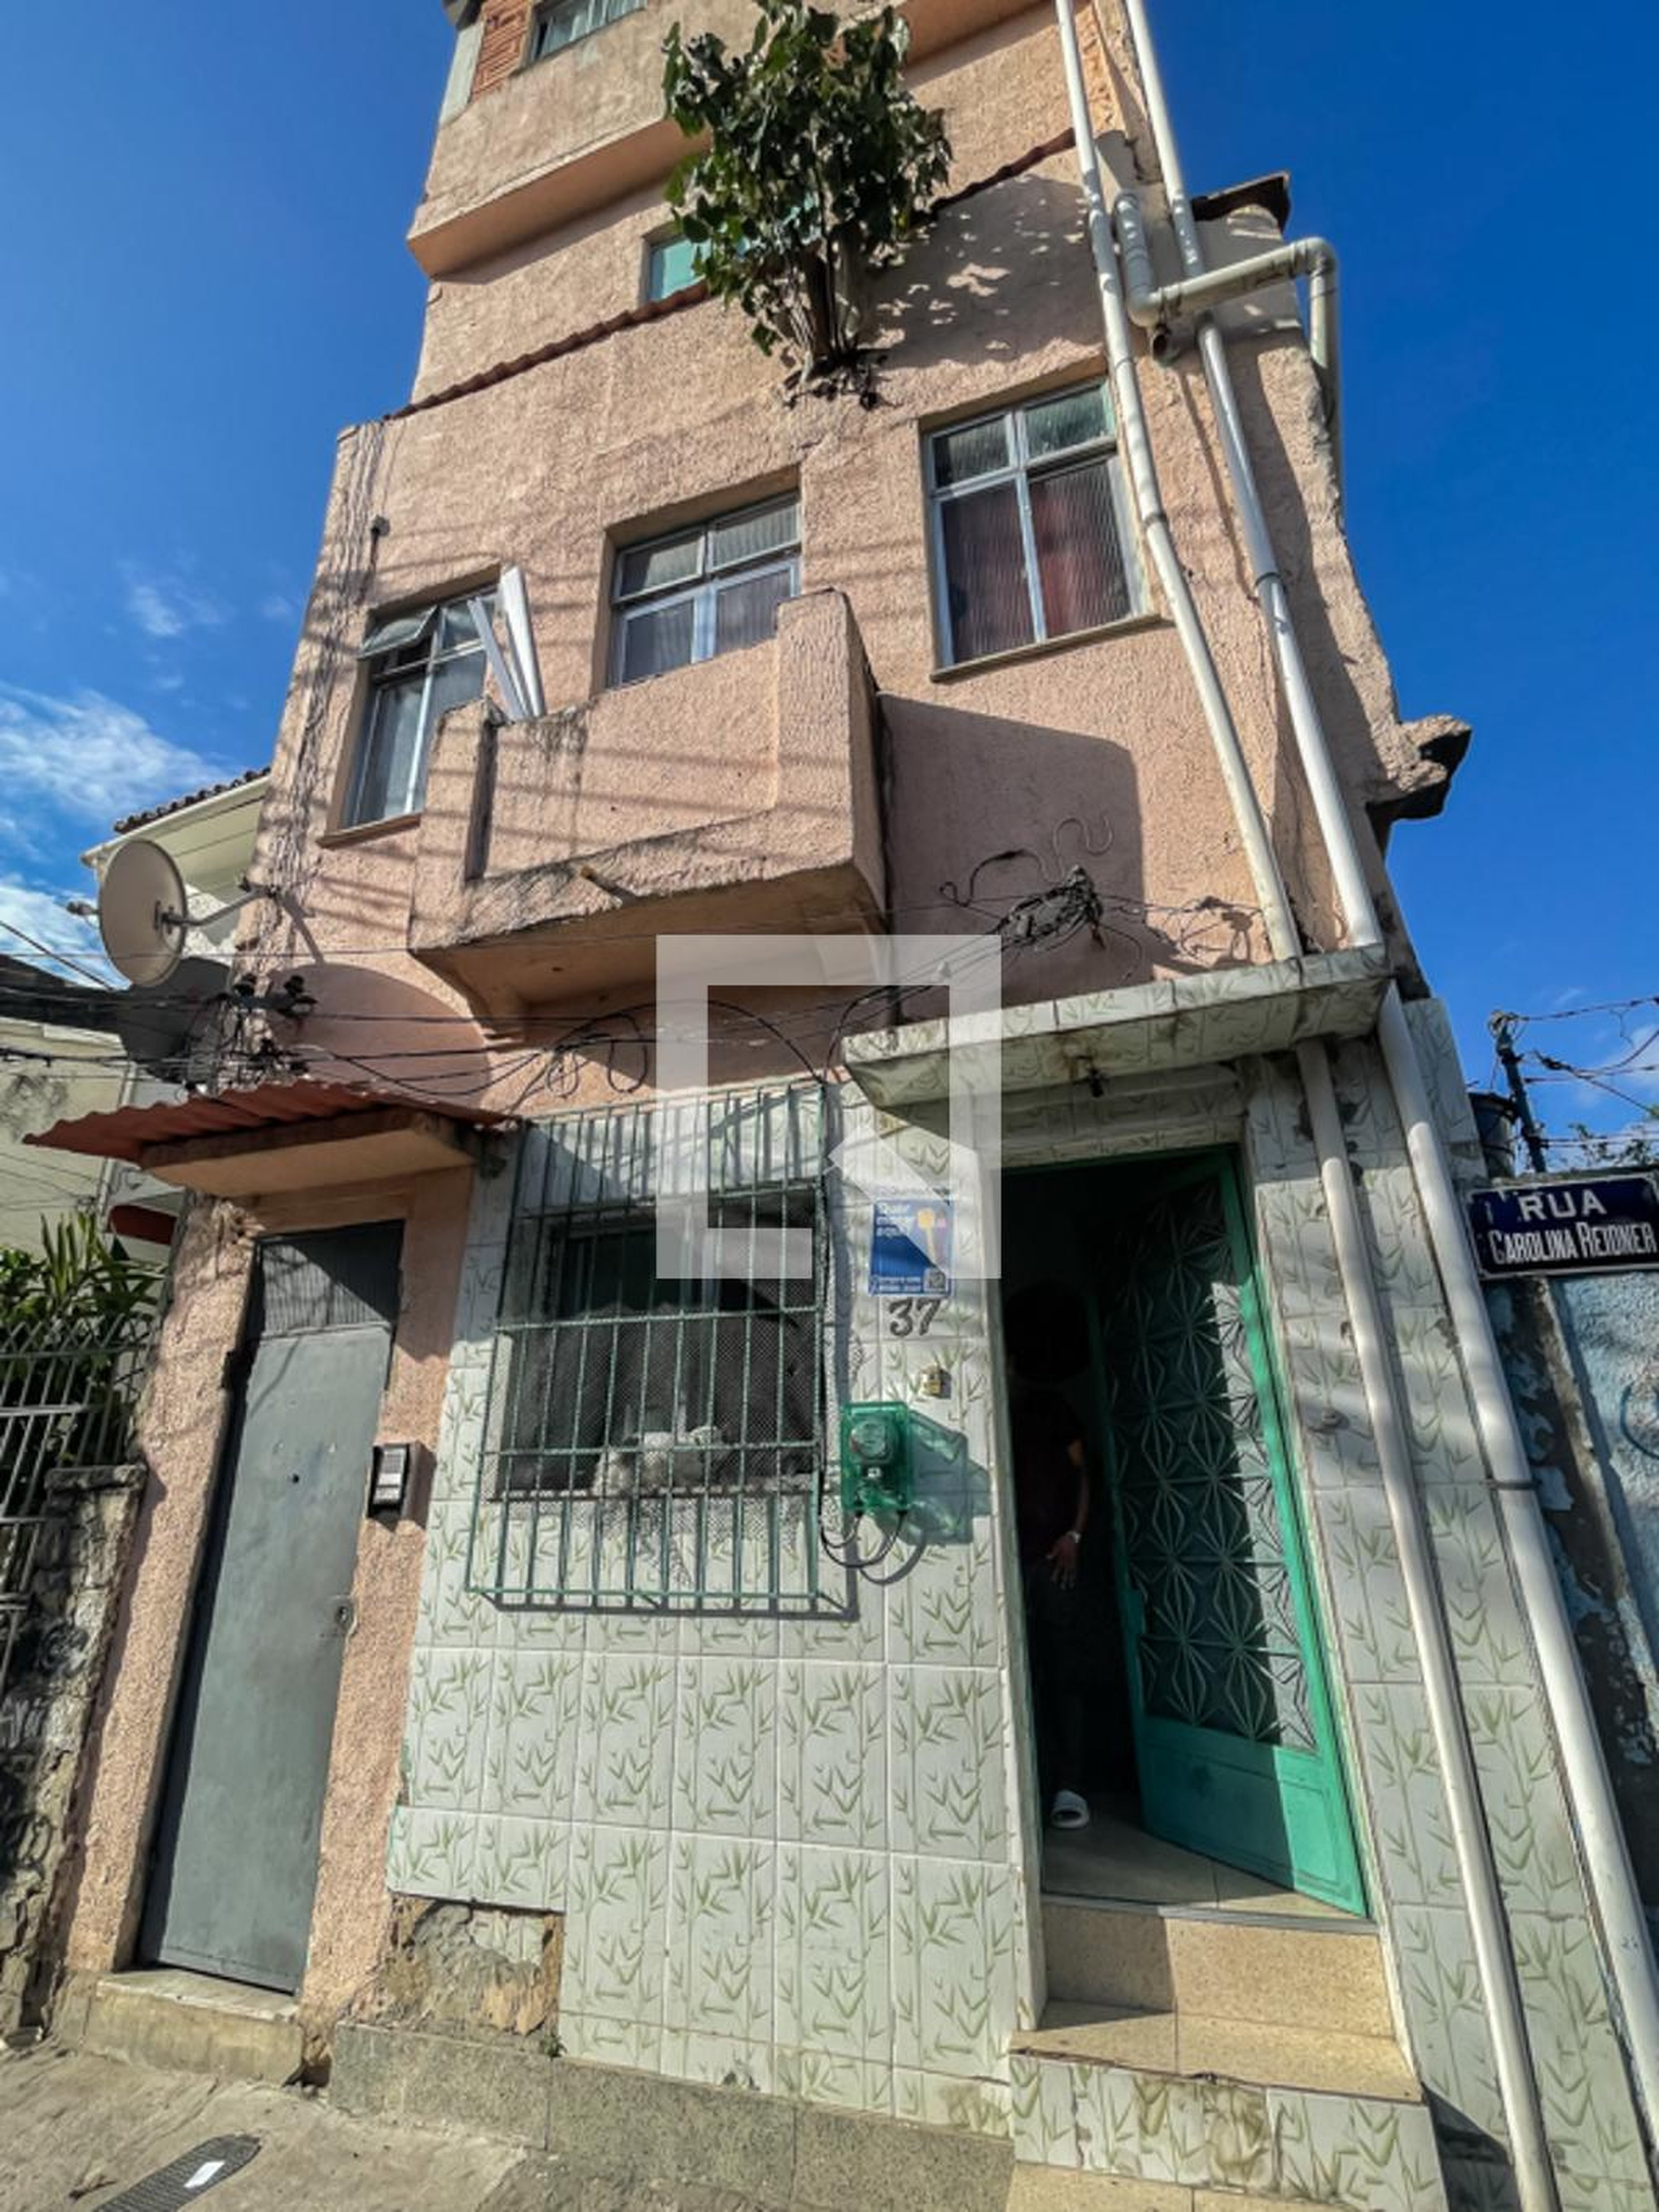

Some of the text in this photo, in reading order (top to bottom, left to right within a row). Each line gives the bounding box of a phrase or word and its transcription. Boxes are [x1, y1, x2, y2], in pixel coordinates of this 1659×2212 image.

[1519, 1189, 1607, 1221] RUA
[1488, 1228, 1579, 1264] CAROLINA
[889, 1297, 941, 1337] 37
